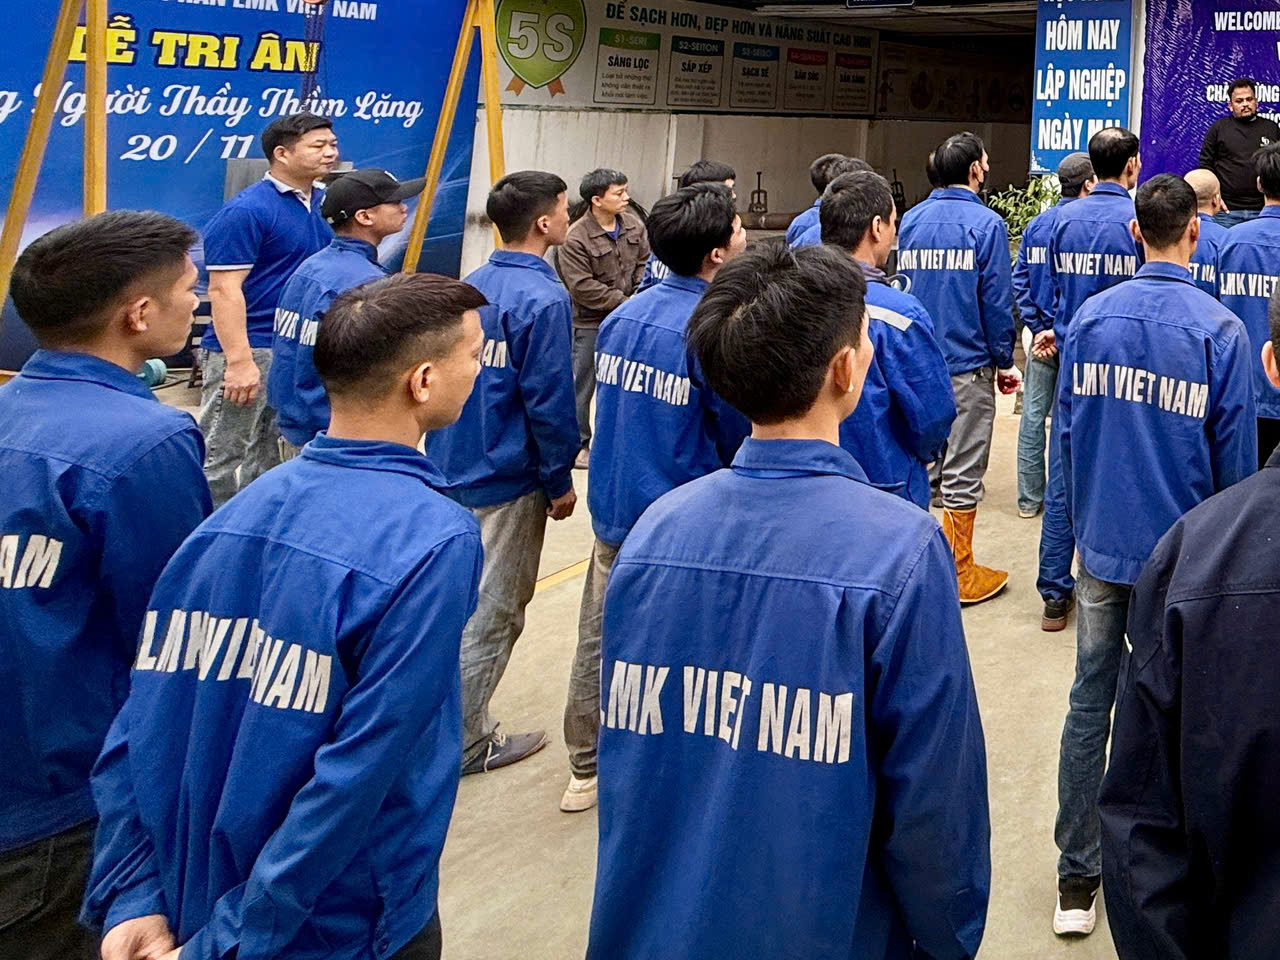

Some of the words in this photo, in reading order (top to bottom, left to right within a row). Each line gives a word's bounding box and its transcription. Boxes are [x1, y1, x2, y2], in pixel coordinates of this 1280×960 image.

[332, 0, 377, 20] NAM
[630, 5, 667, 26] SẠCH
[507, 10, 575, 60] 5S
[1046, 14, 1082, 51] HÔM
[1087, 19, 1120, 50] NAY
[152, 31, 240, 69] TRI
[250, 32, 320, 72] ÂN
[1036, 63, 1065, 107] LẬP
[1068, 63, 1126, 107] NGHIỆP
[1206, 82, 1230, 102] CHÀ
[1255, 82, 1280, 103] ỪNG
[159, 82, 252, 127] Thầy
[353, 91, 423, 128] Lặng
[120, 134, 177, 161] 20
[220, 134, 254, 159] 11
[1038, 112, 1083, 150] NGÀY
[921, 249, 945, 270] VIET
[947, 249, 974, 270] NAM
[1027, 247, 1046, 264] LMK
[1075, 253, 1101, 275] VIET
[1104, 254, 1136, 276] NAM
[1220, 273, 1246, 295] LMK
[1248, 273, 1278, 298] VIET
[653, 369, 690, 406] NAM
[1073, 363, 1109, 396] LMK
[1114, 365, 1155, 404] VIET
[1159, 376, 1209, 418] NAM
[250, 636, 332, 713] NAM
[600, 658, 670, 736] MK
[683, 665, 751, 751] VIET
[757, 682, 853, 764] NAM
